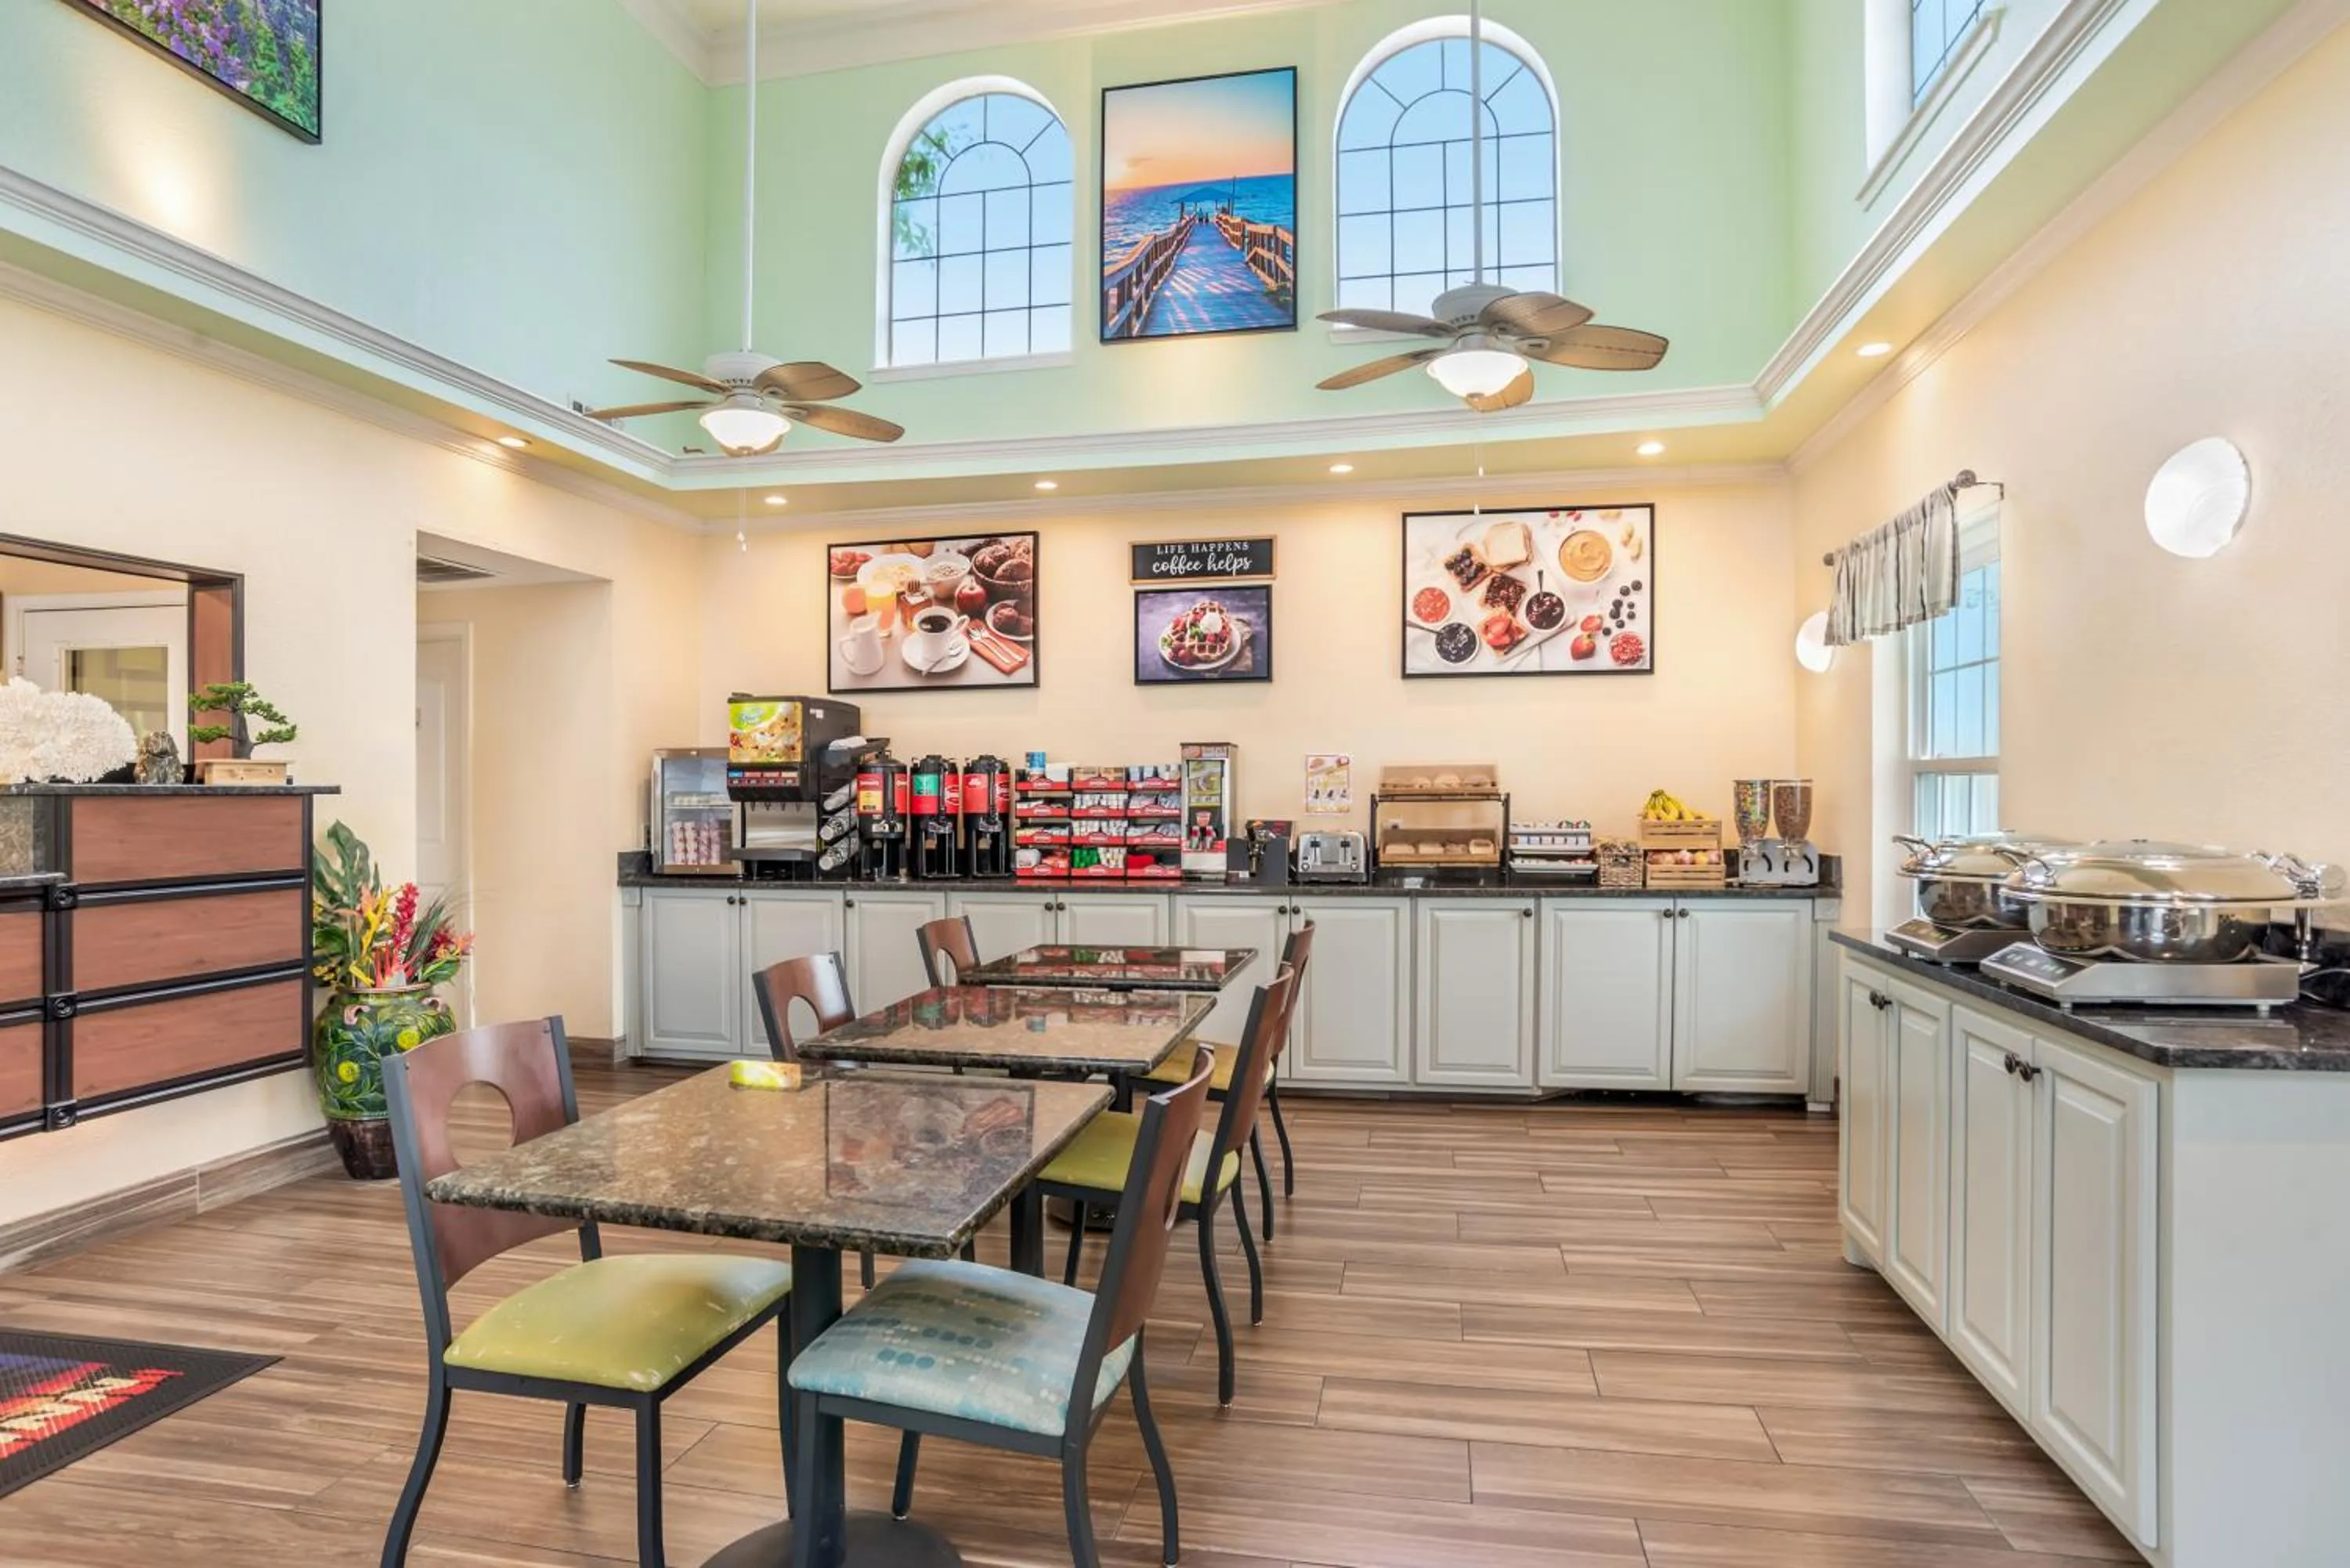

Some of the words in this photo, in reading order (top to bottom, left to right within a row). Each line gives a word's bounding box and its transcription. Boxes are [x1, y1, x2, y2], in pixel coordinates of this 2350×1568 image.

[1157, 544, 1184, 555] LIFE
[1191, 541, 1249, 555] HAPPENS
[1152, 554, 1203, 575] coffee
[1207, 553, 1253, 576] helps
